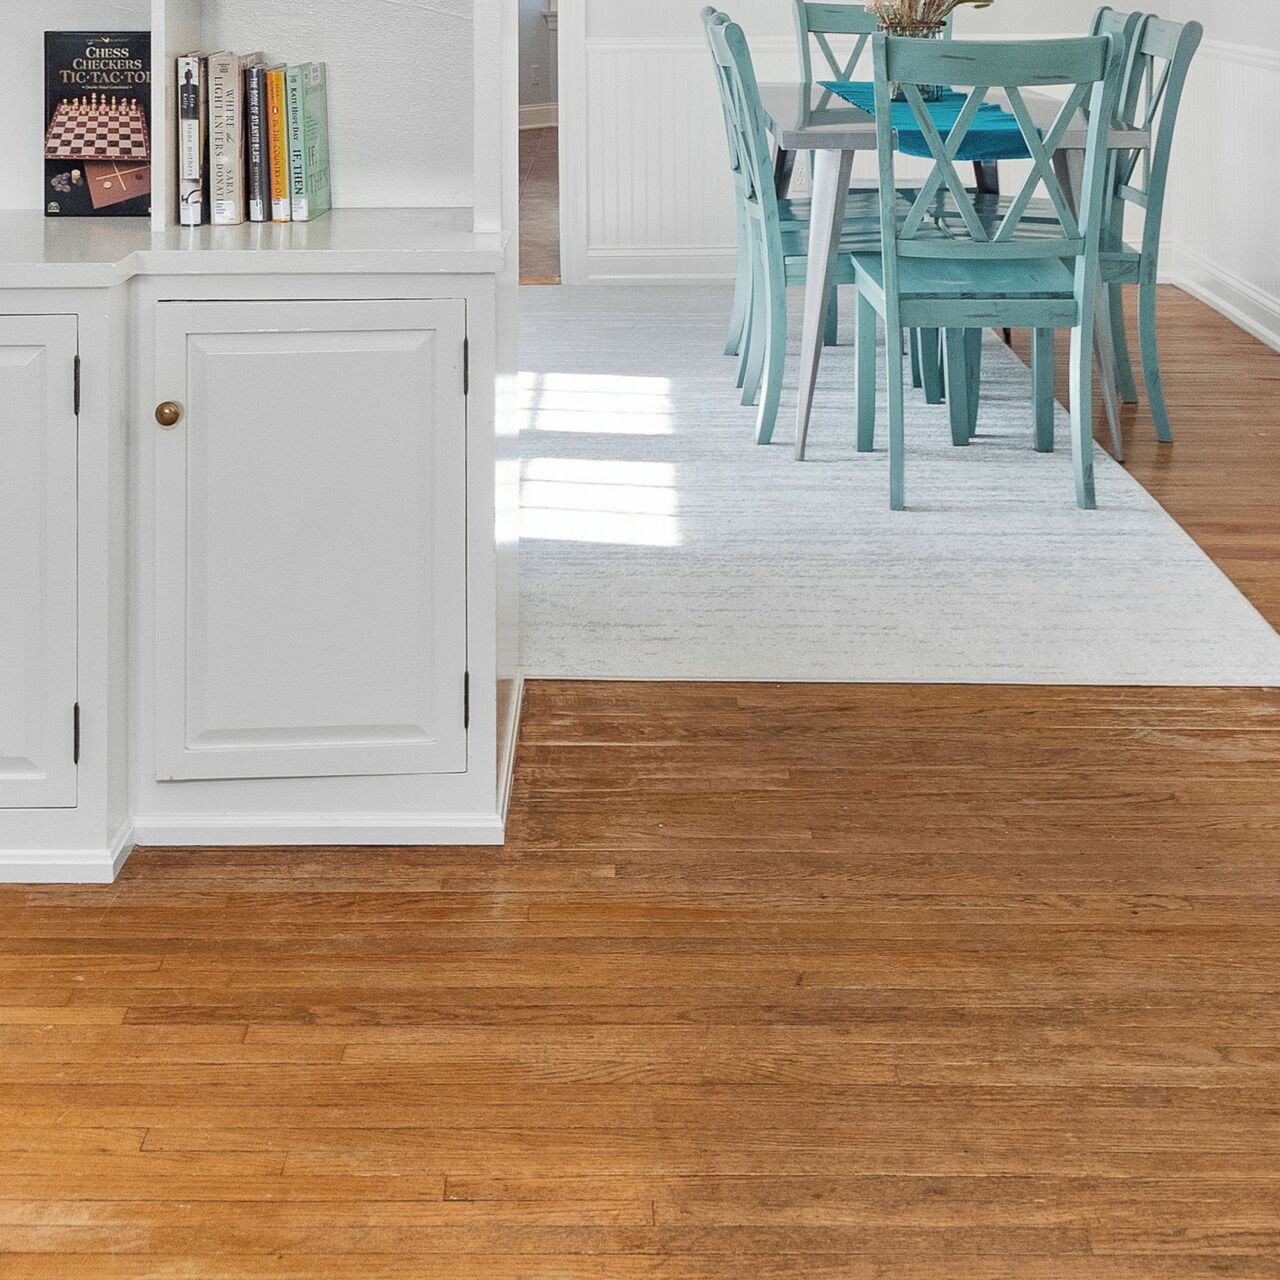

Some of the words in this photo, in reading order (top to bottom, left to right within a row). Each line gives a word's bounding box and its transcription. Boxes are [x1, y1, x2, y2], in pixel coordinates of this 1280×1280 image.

[85, 46, 129, 58] CHESS
[72, 58, 142, 70] CHECKERS
[250, 78, 258, 89] THE
[214, 76, 223, 109] LIGHT
[251, 90, 259, 105] BOOK
[226, 89, 234, 128] WHERE
[251, 106, 259, 114] OF
[273, 119, 278, 128] IN
[214, 115, 223, 157] ENTERS
[252, 144, 260, 163] BLACK
[292, 149, 302, 163] IF,
[226, 169, 234, 195] SARA
[293, 166, 303, 195] THEN
